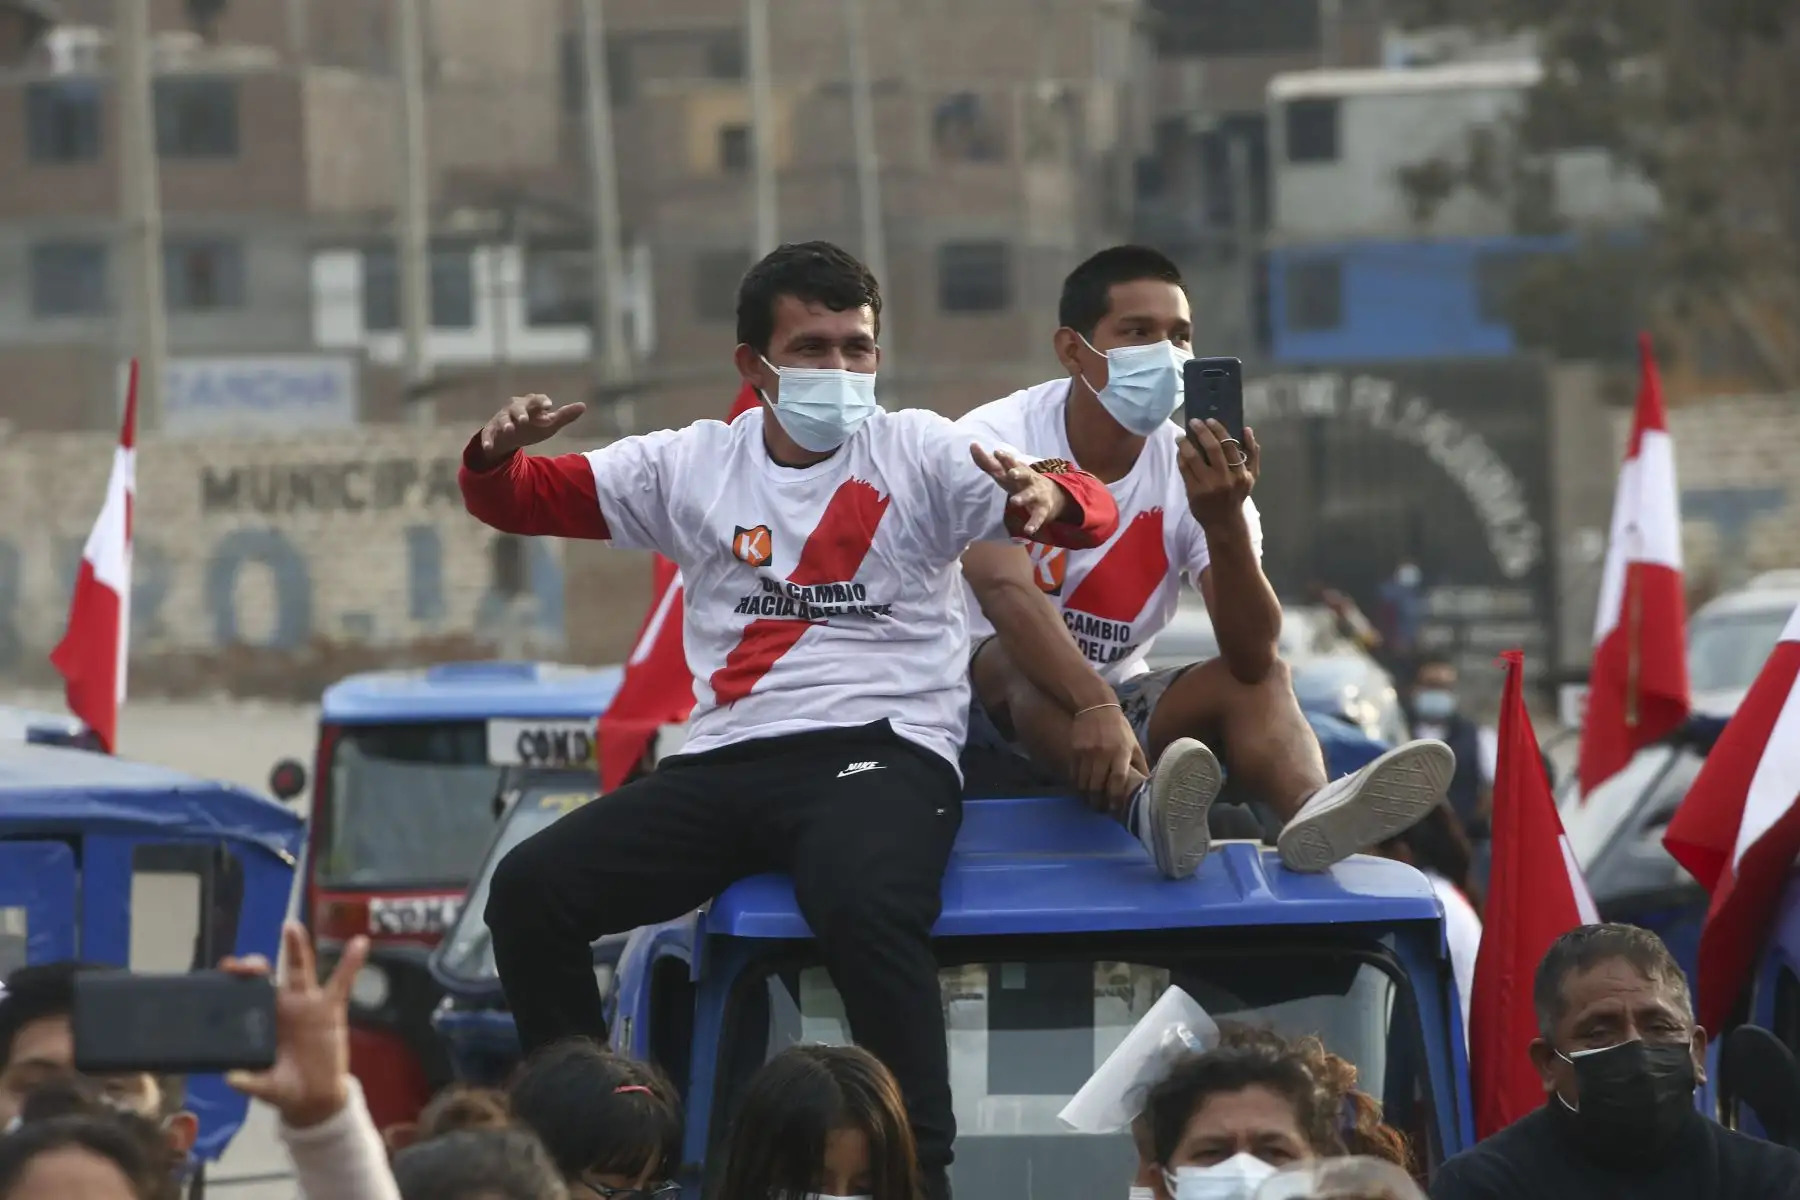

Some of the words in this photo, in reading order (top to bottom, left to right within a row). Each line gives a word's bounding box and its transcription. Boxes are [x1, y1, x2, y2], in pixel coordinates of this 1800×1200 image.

[202, 457, 462, 512] MUNICIPA
[739, 531, 765, 561] K
[734, 595, 797, 616] HACIA
[786, 583, 867, 603] CAMBIO
[1062, 611, 1130, 643] CAMBIO
